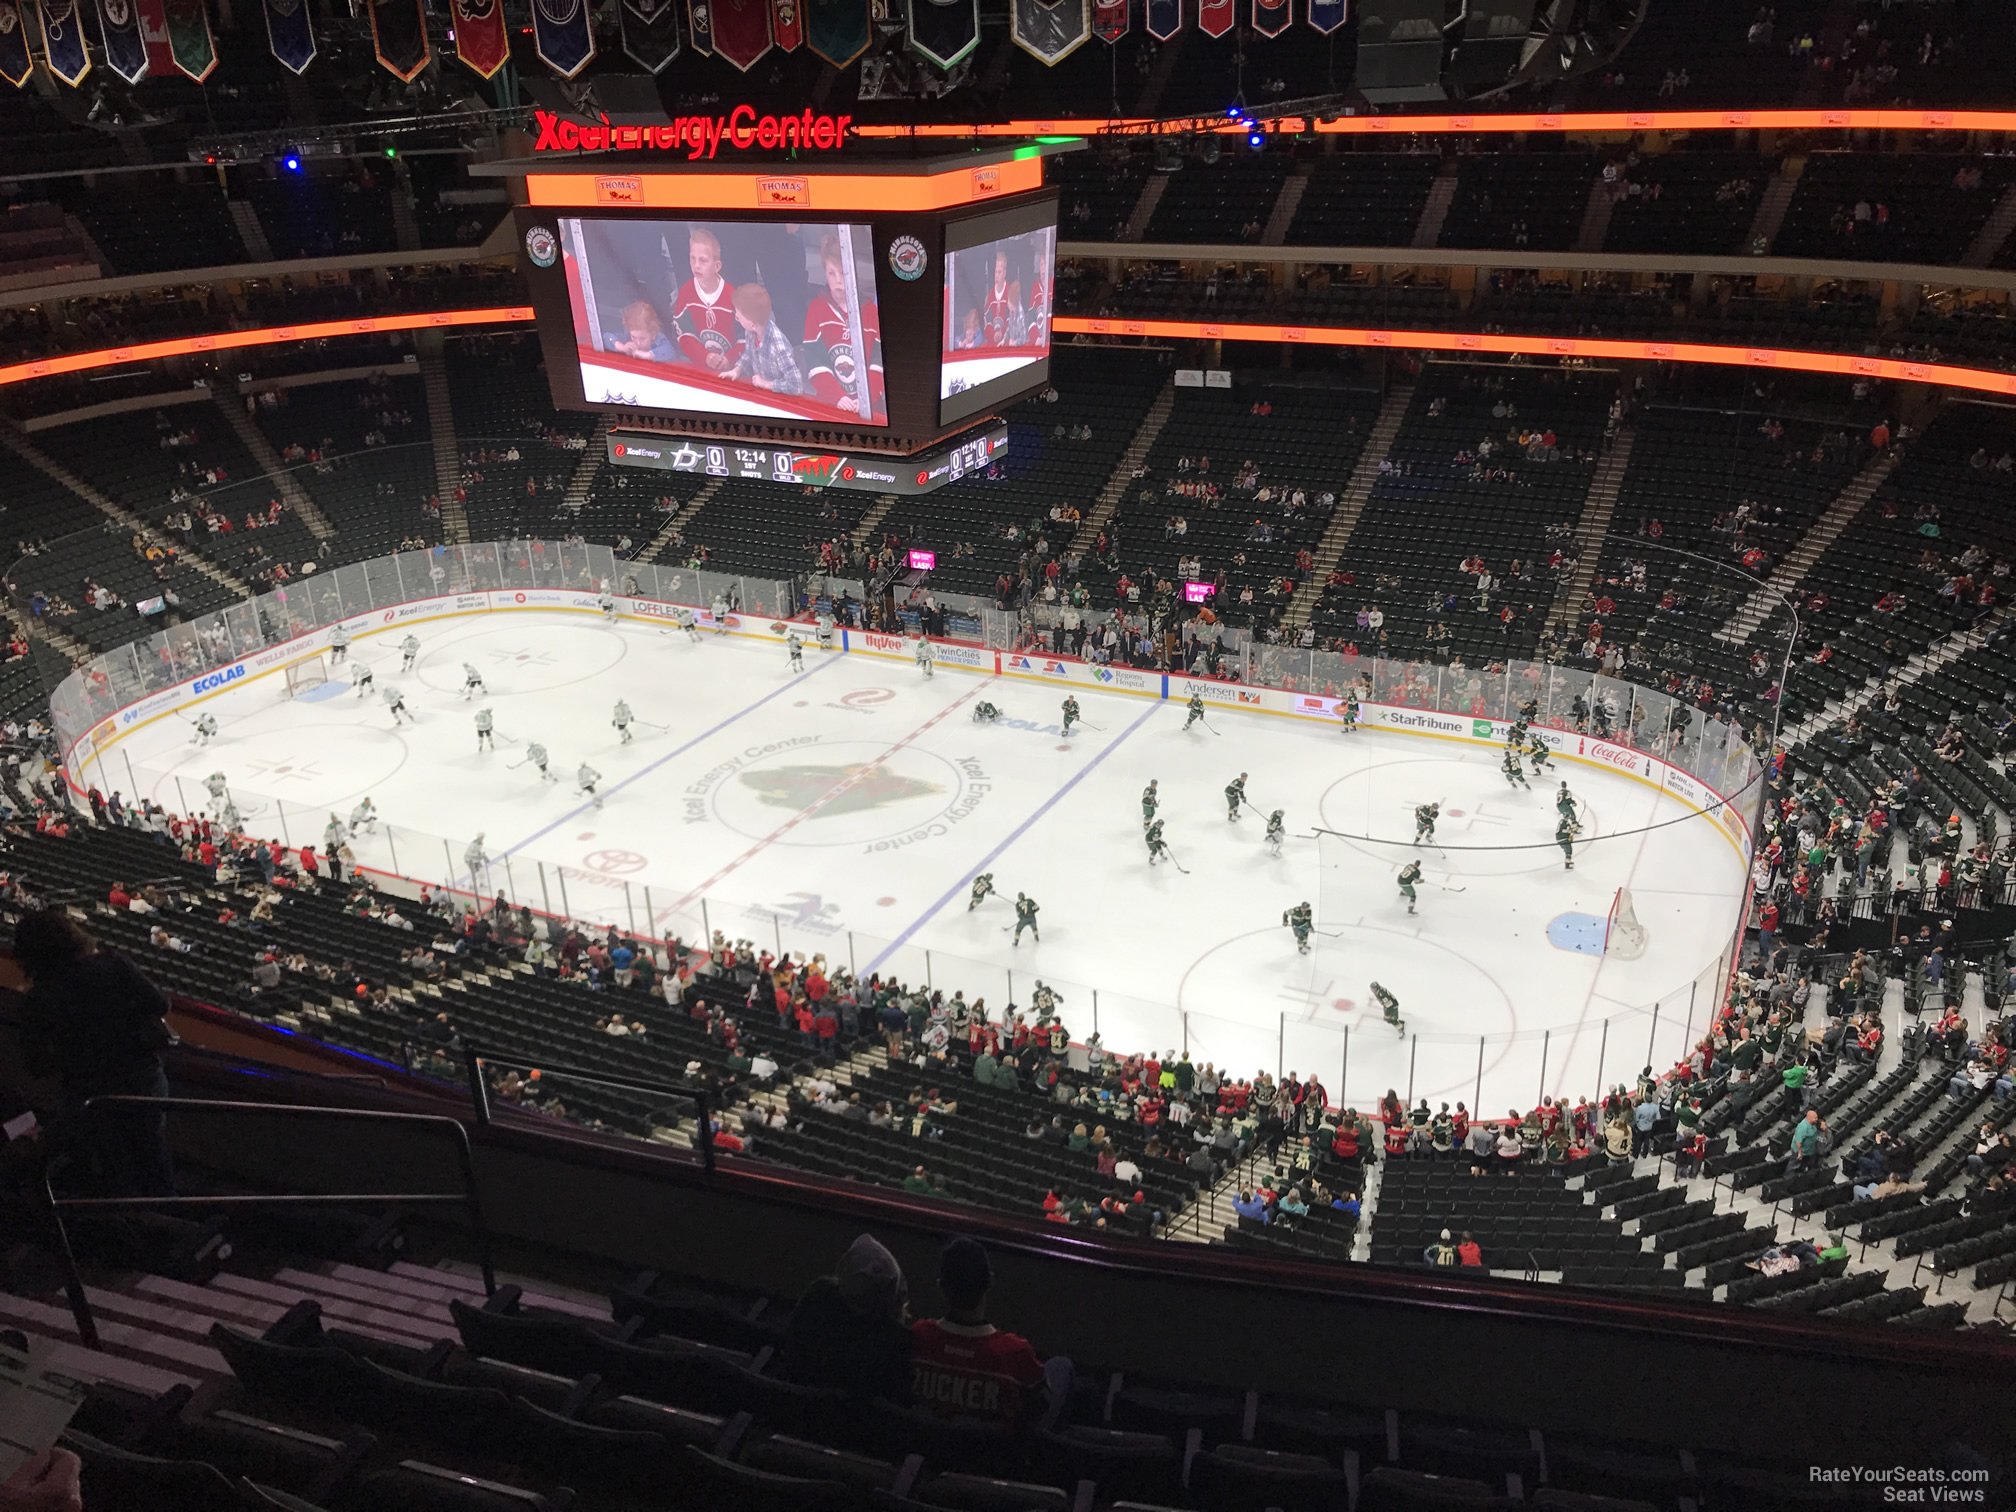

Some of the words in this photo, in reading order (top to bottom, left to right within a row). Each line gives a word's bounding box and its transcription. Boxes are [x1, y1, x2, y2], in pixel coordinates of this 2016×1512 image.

[730, 104, 851, 149] Center
[600, 181, 637, 190] THOMAS
[762, 183, 802, 191] THOMAS
[889, 235, 925, 256] MINNESOTA
[735, 449, 766, 464] 12:14
[962, 441, 977, 456] 12:14
[978, 441, 985, 457] 0
[710, 449, 721, 466] 0
[777, 455, 789, 472] 0
[953, 453, 960, 470] 0
[741, 470, 762, 479] SHOTS
[632, 601, 679, 617] LOFFLER
[256, 649, 285, 667] WELLS
[193, 664, 246, 695] ECOLAB
[1116, 671, 1143, 684] Regions
[1116, 677, 1145, 688] Hospital
[1184, 680, 1236, 697] Andersen
[1390, 711, 1463, 732] StarTribune
[684, 755, 744, 796] Energy
[743, 734, 824, 759] Center
[1667, 780, 1684, 794] WATCH
[1683, 787, 1695, 799] LIVE
[943, 782, 993, 824] Energy
[863, 823, 949, 855] Center
[1619, 1138, 1628, 1151] 4
